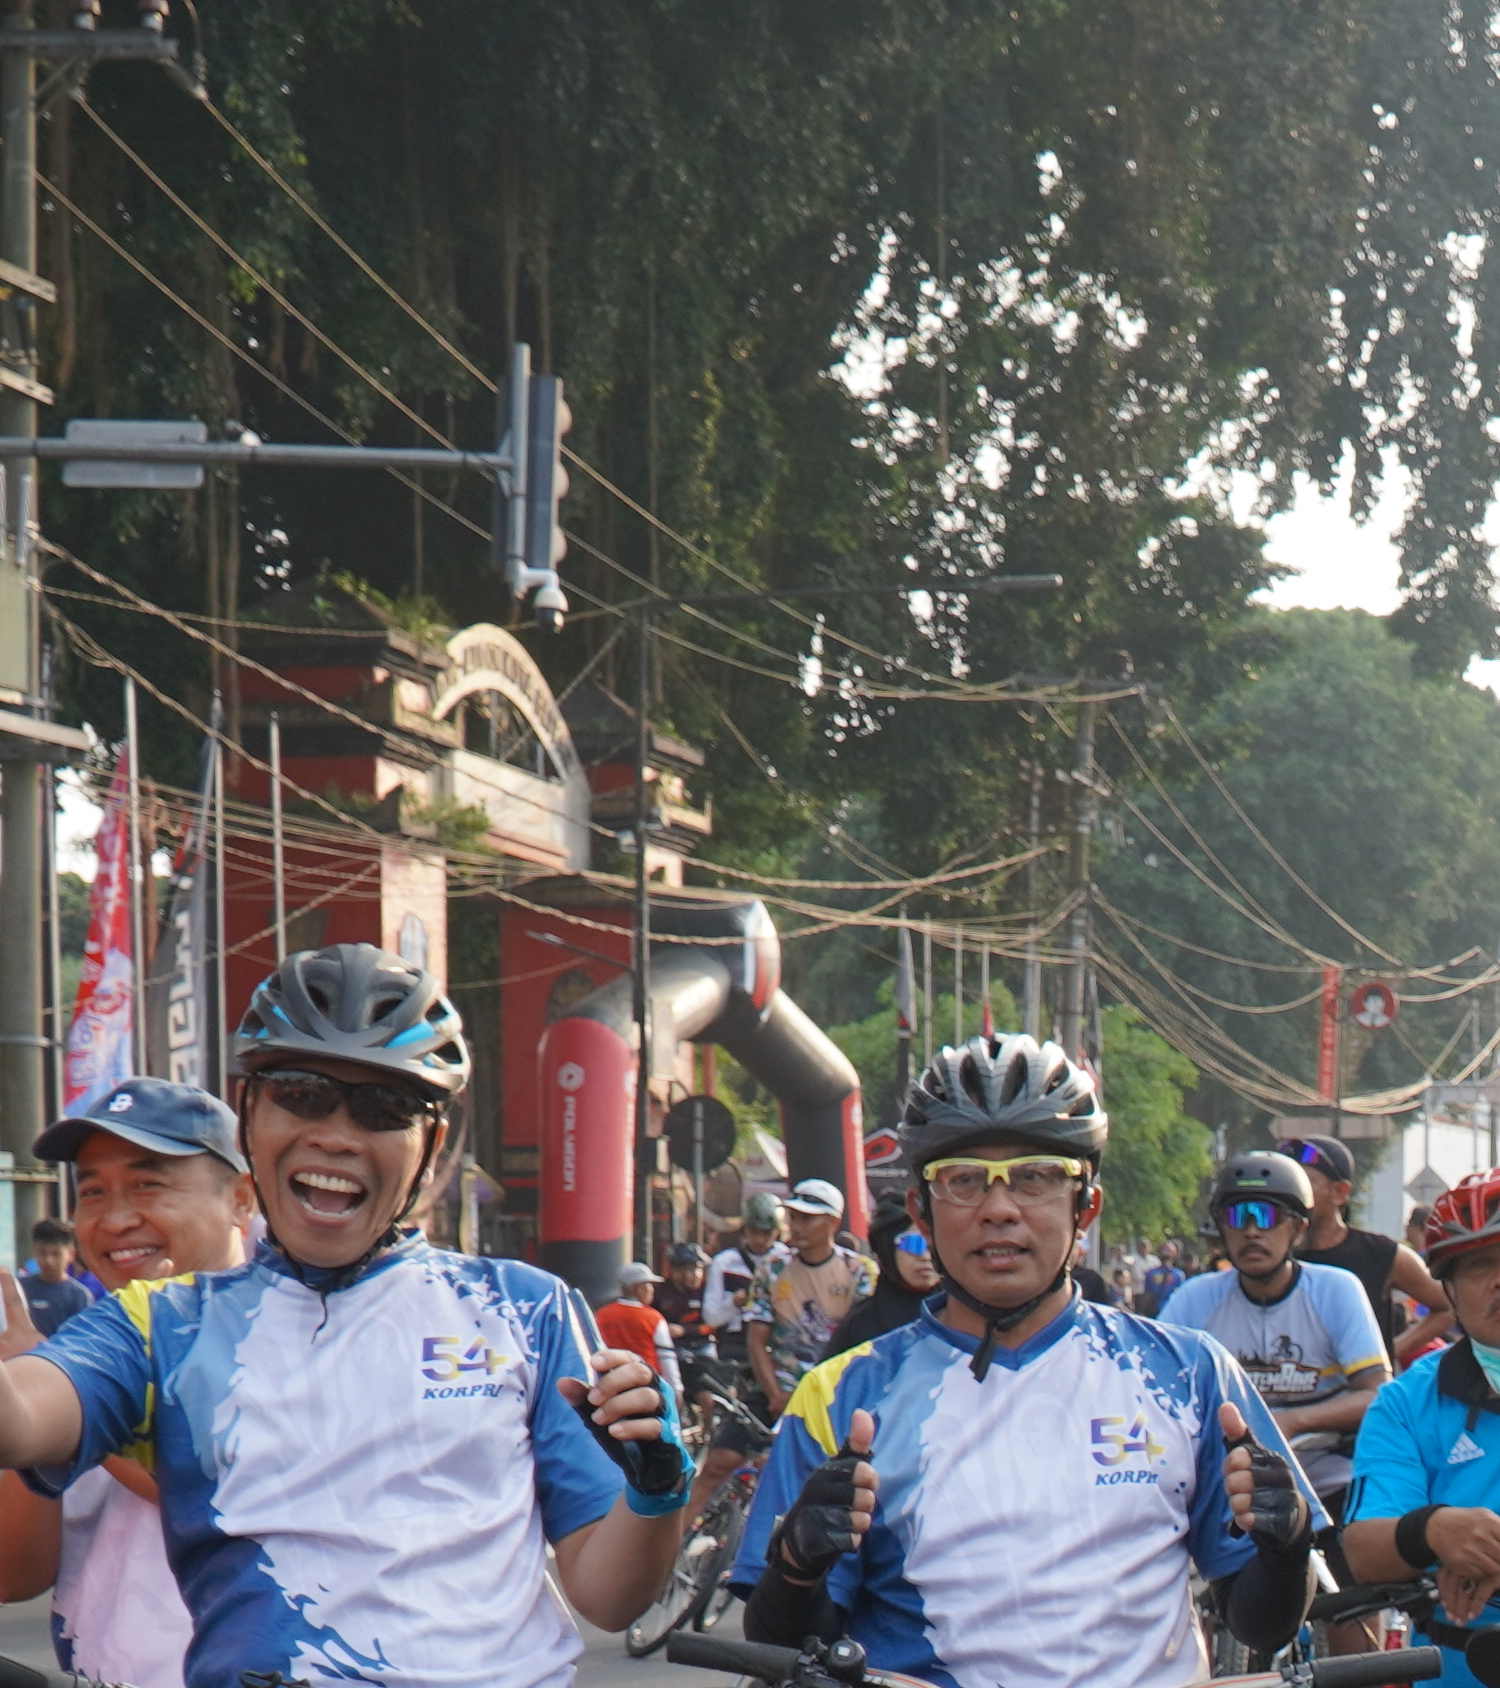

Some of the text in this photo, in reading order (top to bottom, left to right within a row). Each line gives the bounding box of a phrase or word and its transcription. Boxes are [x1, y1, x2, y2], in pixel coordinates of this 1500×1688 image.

[422, 1335, 509, 1381] 54
[423, 1383, 505, 1400] KORPRI
[1091, 1413, 1166, 1466] 54
